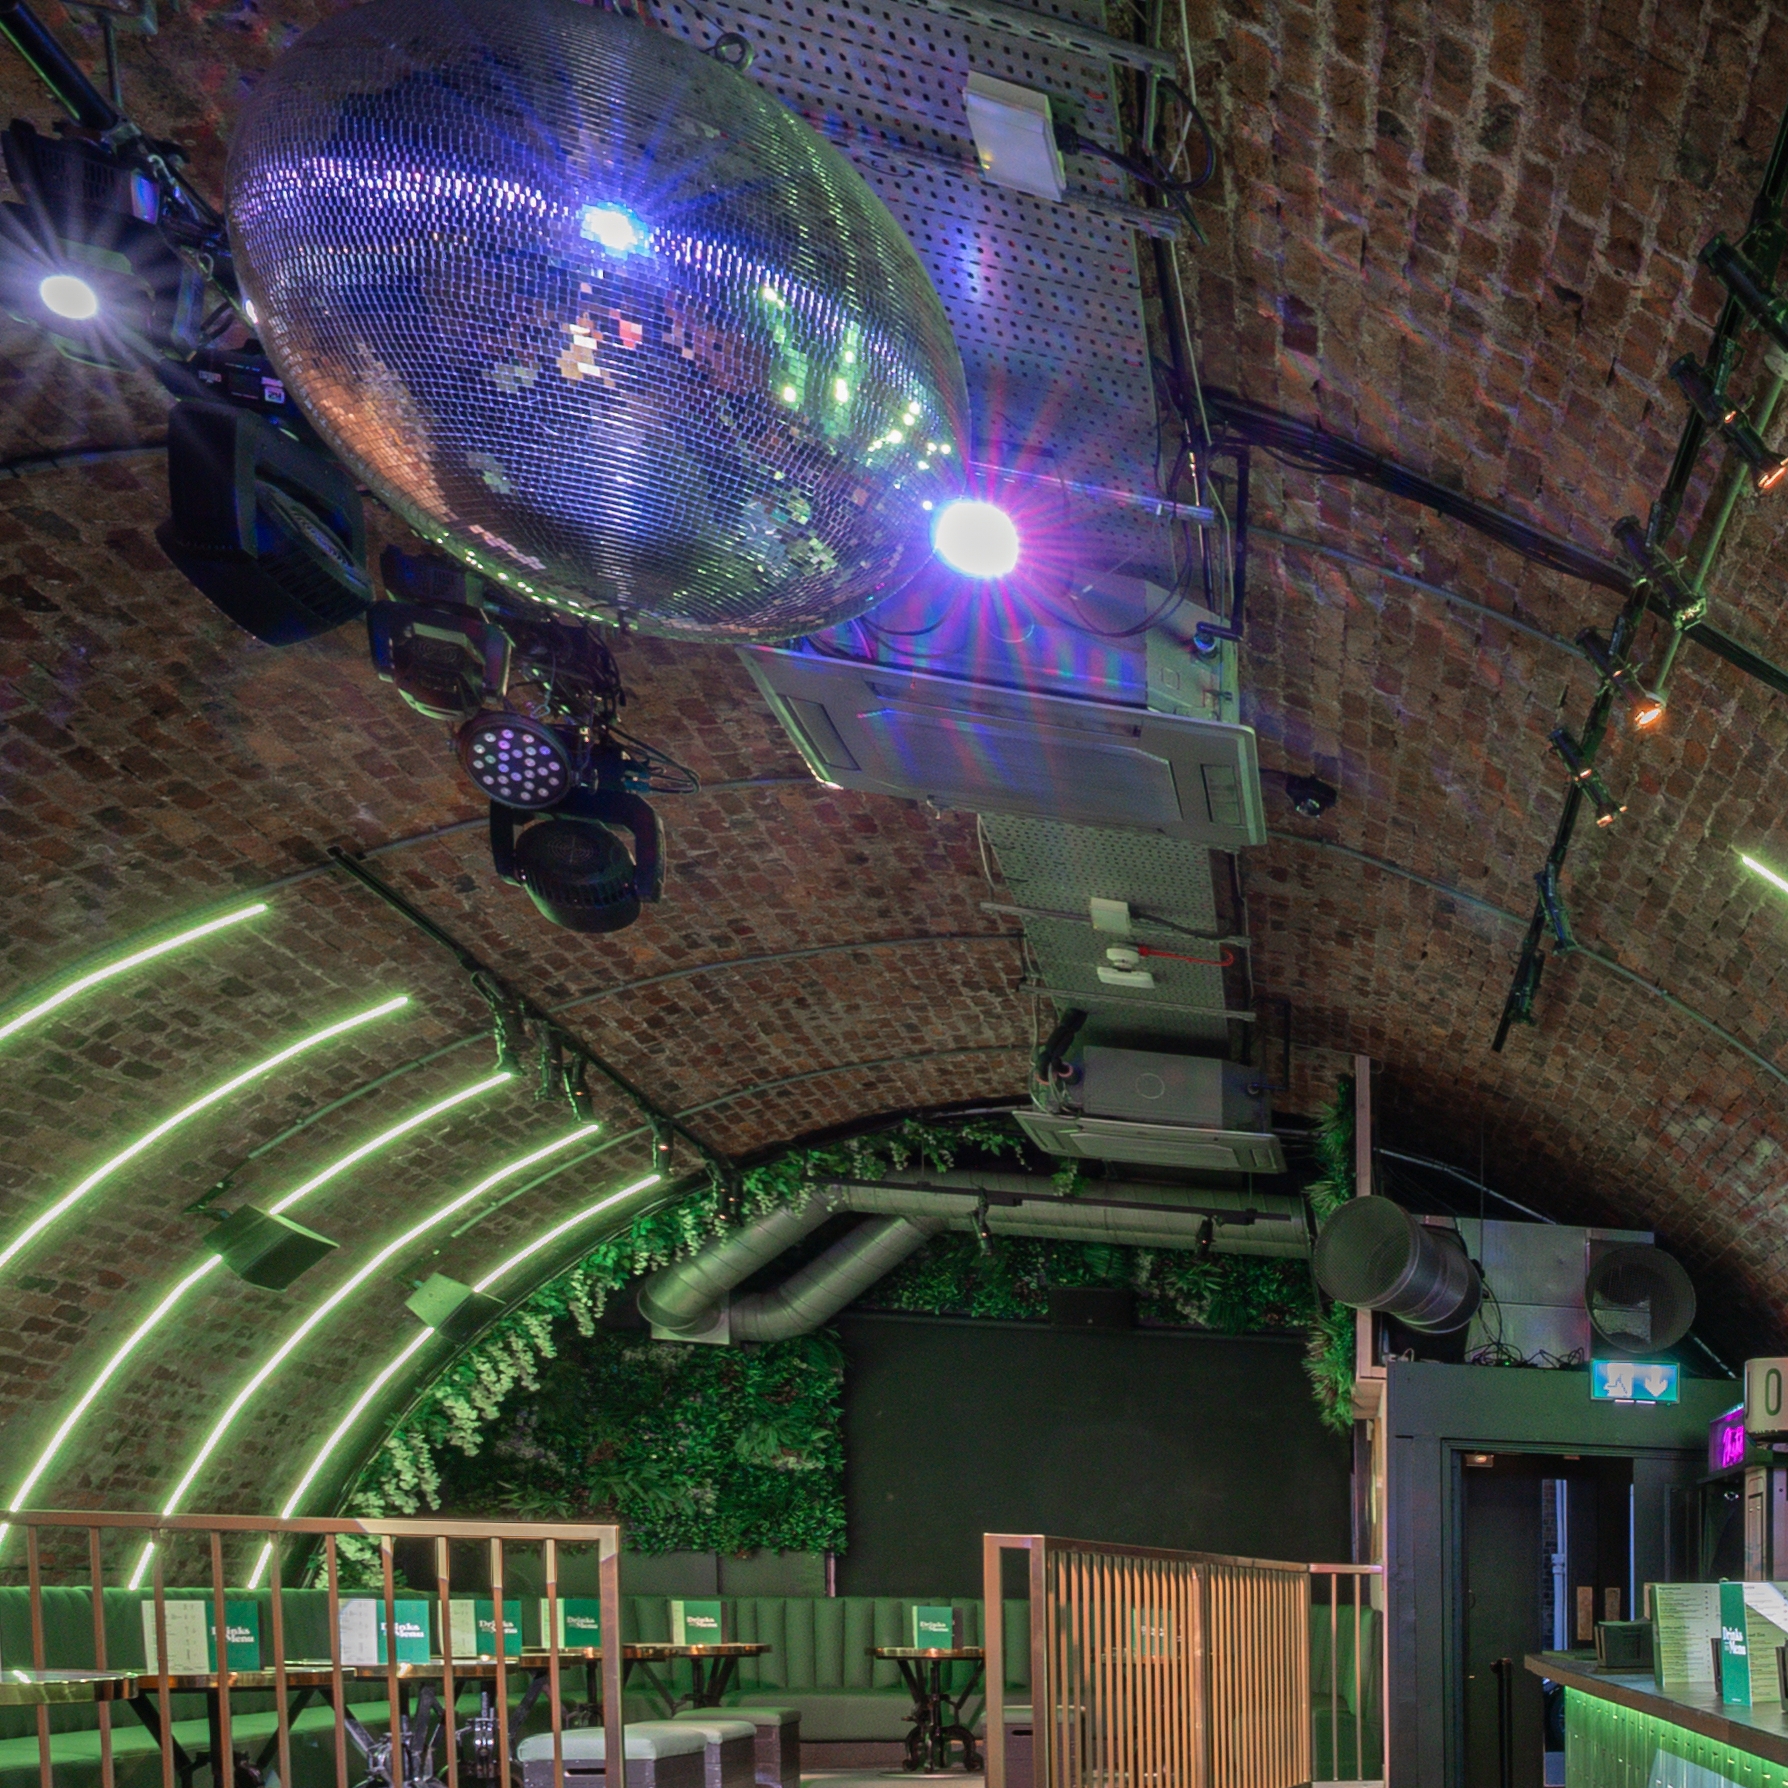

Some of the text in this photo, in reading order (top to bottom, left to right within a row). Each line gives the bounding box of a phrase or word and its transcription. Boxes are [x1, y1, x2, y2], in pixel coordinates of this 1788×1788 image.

[381, 1621, 421, 1631] Dinks
[479, 1619, 515, 1628] Driks
[211, 1625, 251, 1636] Dinks
